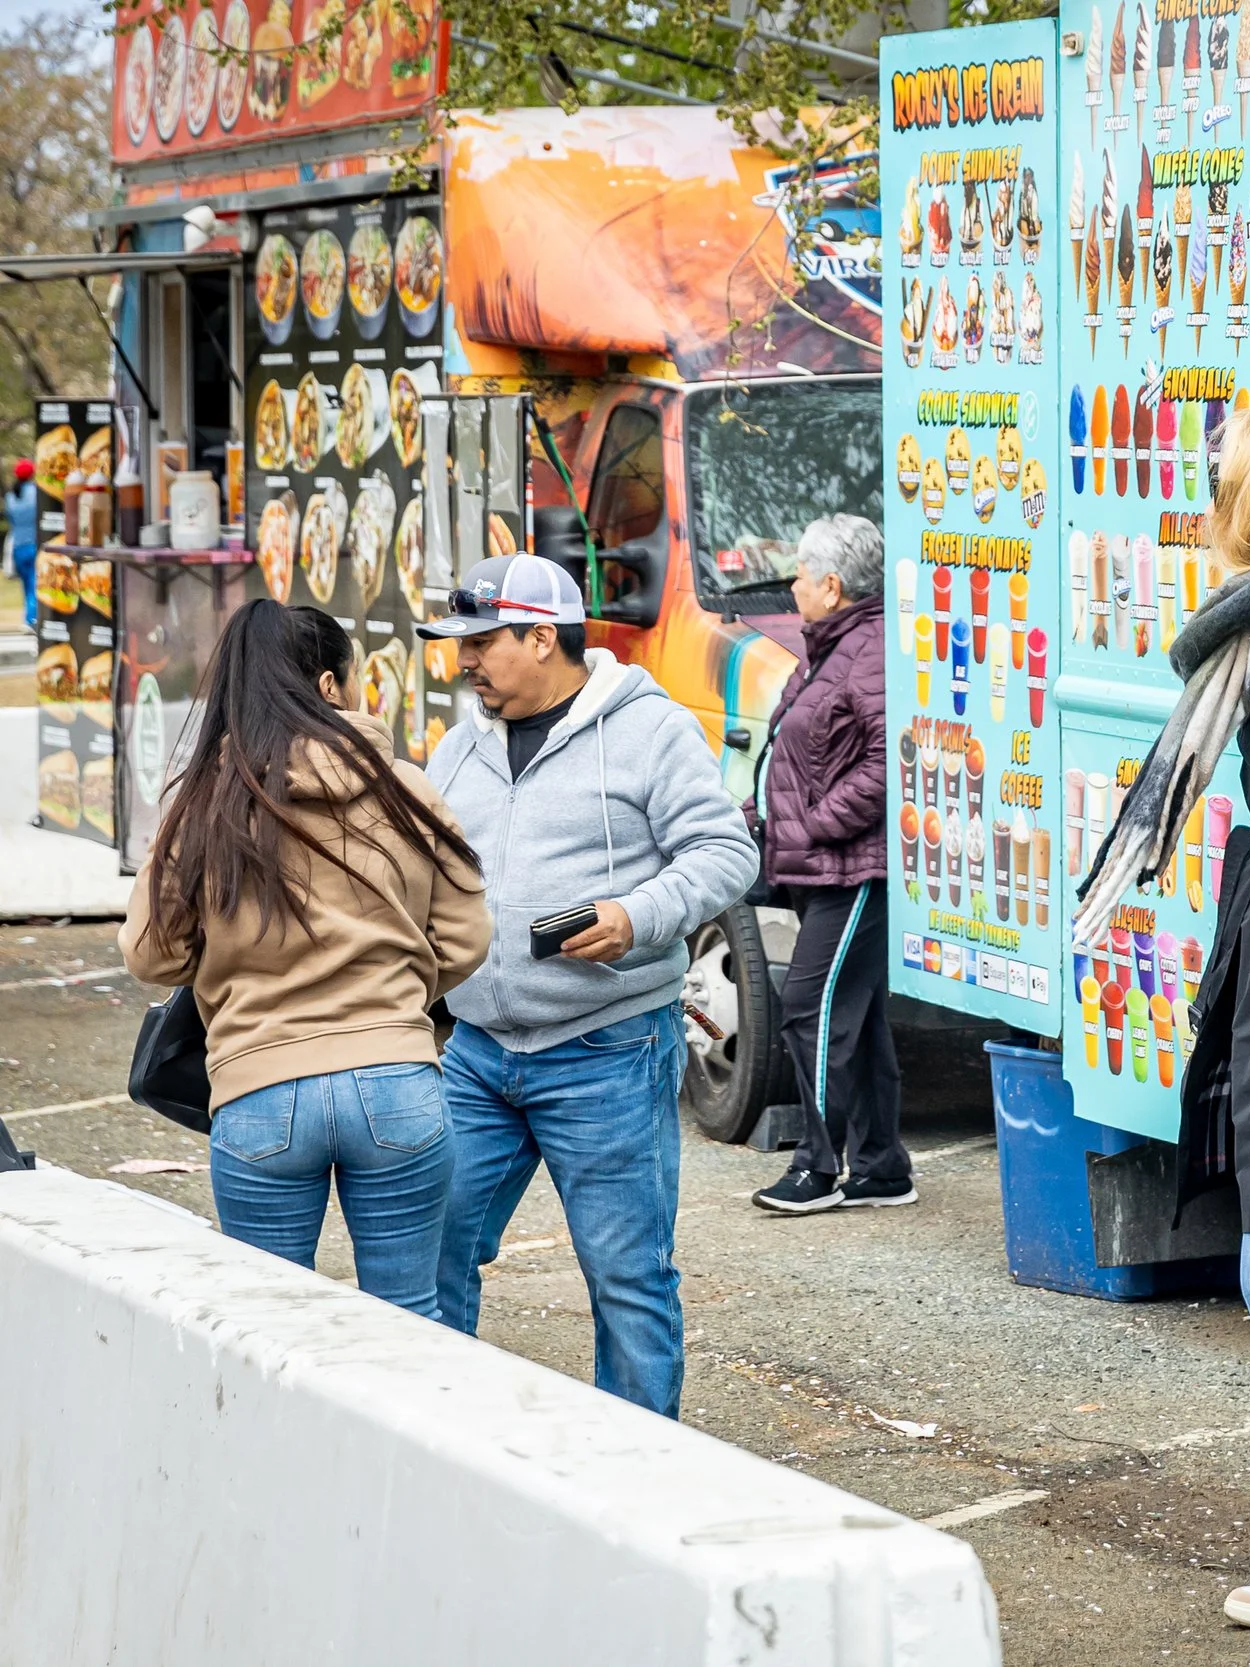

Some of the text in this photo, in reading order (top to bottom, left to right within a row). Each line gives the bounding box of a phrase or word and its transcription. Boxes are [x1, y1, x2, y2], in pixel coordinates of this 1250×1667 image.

[892, 56, 1044, 134] ROCKY'S ICE CREAM
[1202, 104, 1232, 132] OREO
[919, 150, 961, 187] DONUT
[1153, 147, 1245, 189] WAFFLE CONES
[1163, 366, 1236, 403] SNOWBALLS
[917, 389, 1020, 429] COOKIE SANDWICH
[920, 529, 1032, 576] FROZEN LEMONADES
[1011, 729, 1031, 766] ICE
[1000, 769, 1043, 810] COFFEE
